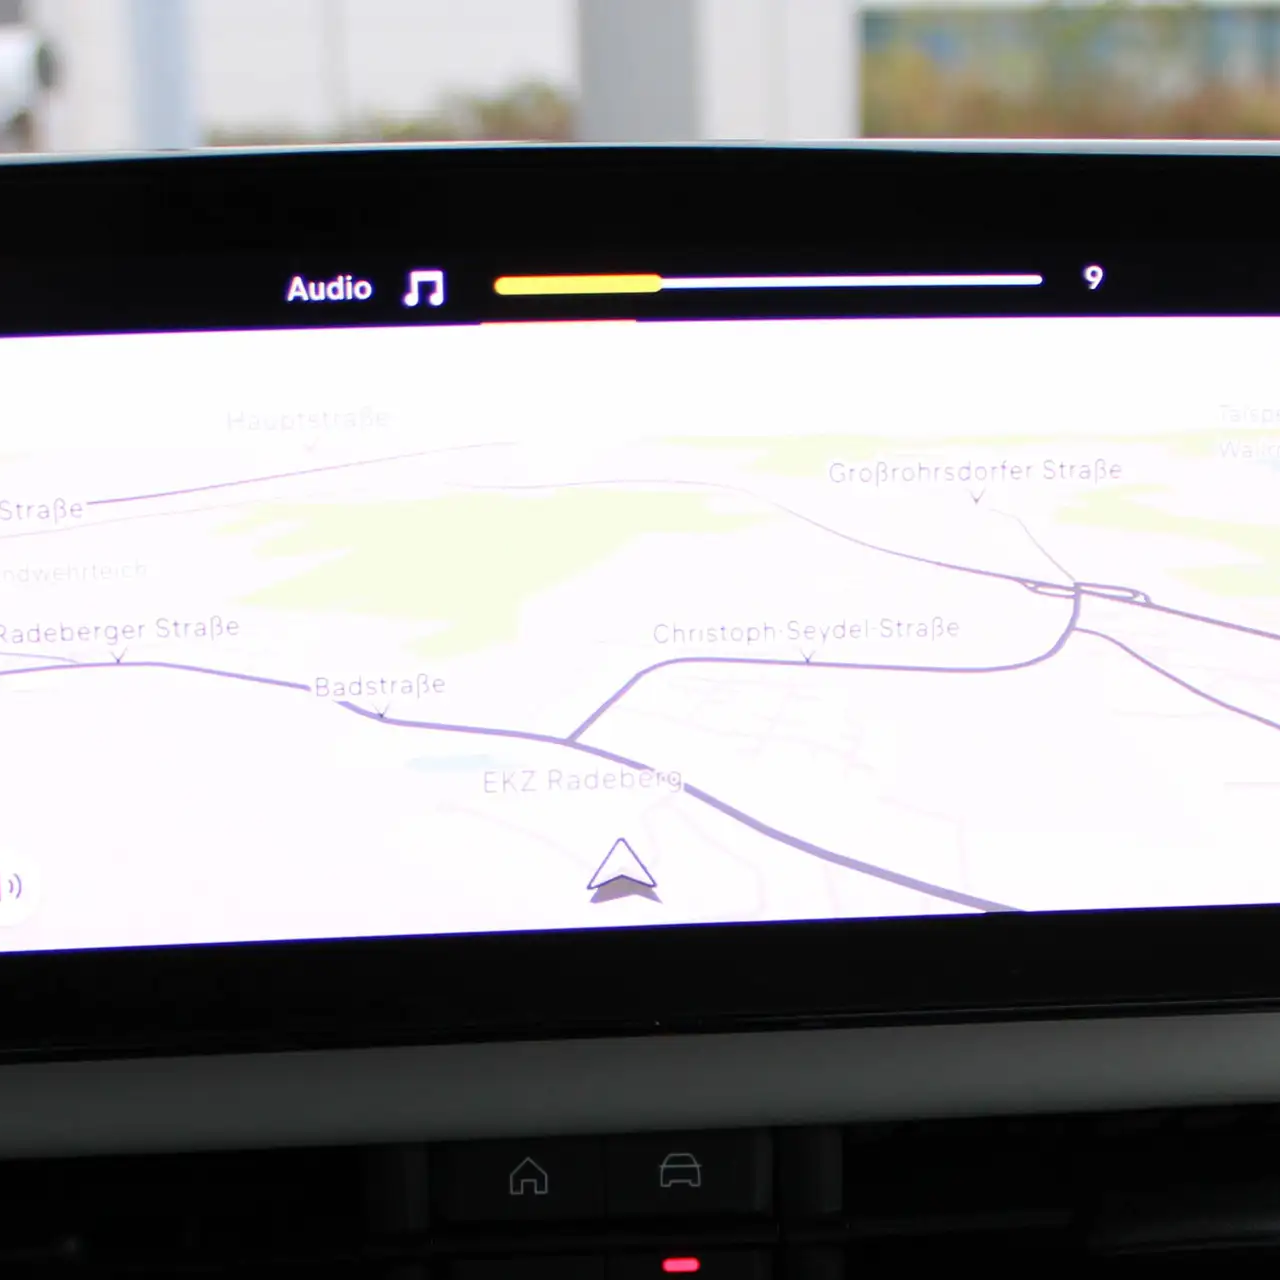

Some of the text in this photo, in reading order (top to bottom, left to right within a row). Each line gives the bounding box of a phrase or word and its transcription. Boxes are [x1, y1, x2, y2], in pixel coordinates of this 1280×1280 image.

[285, 274, 375, 303] Audio
[1082, 264, 1105, 290] 9
[828, 458, 1123, 487] Großrohrsdorfer Straße
[156, 615, 239, 638] Straße
[315, 673, 445, 699] Badstraße
[483, 768, 683, 794] EKZ Radeberg
